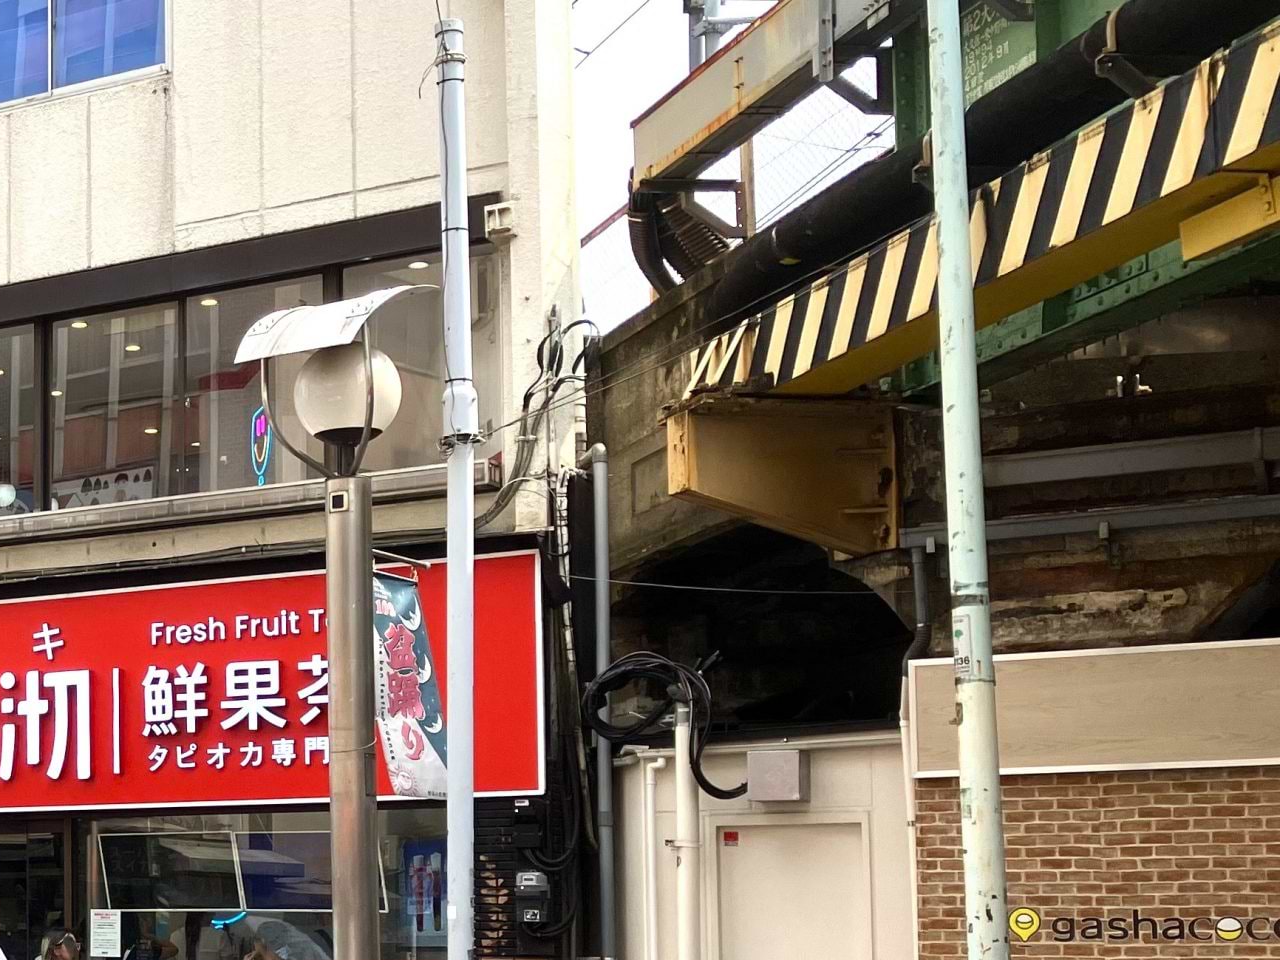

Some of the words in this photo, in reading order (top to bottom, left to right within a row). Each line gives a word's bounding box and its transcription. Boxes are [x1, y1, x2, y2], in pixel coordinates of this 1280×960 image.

[32, 622, 64, 661] キ
[150, 615, 226, 646] Fresh
[235, 609, 300, 639] Fruit
[308, 607, 330, 634] T
[1051, 909, 1280, 943] gashacoc
